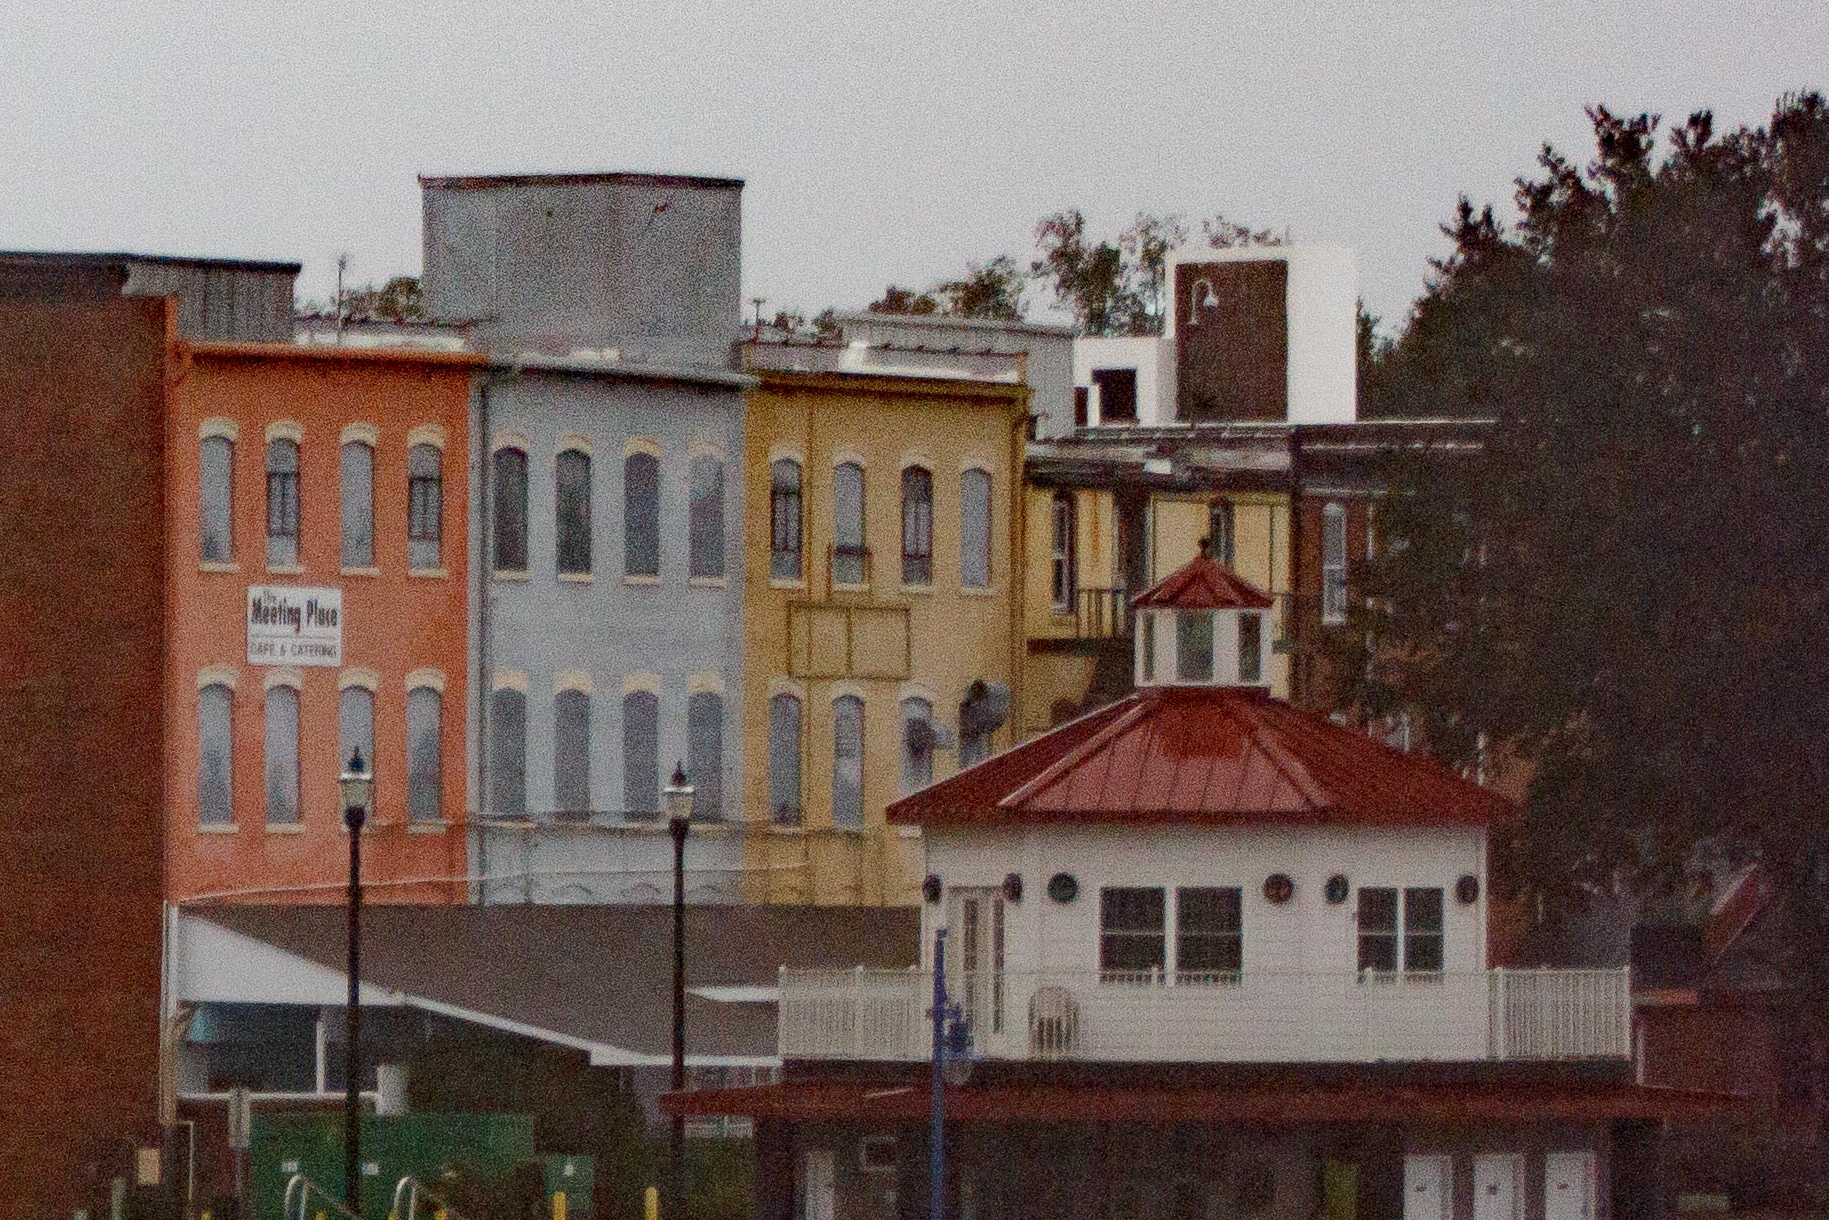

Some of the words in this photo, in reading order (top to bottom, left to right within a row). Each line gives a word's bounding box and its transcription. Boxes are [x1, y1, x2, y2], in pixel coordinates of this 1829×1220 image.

[251, 597, 301, 634] Meeting
[306, 598, 339, 628] Place
[290, 644, 338, 658] CATERING
